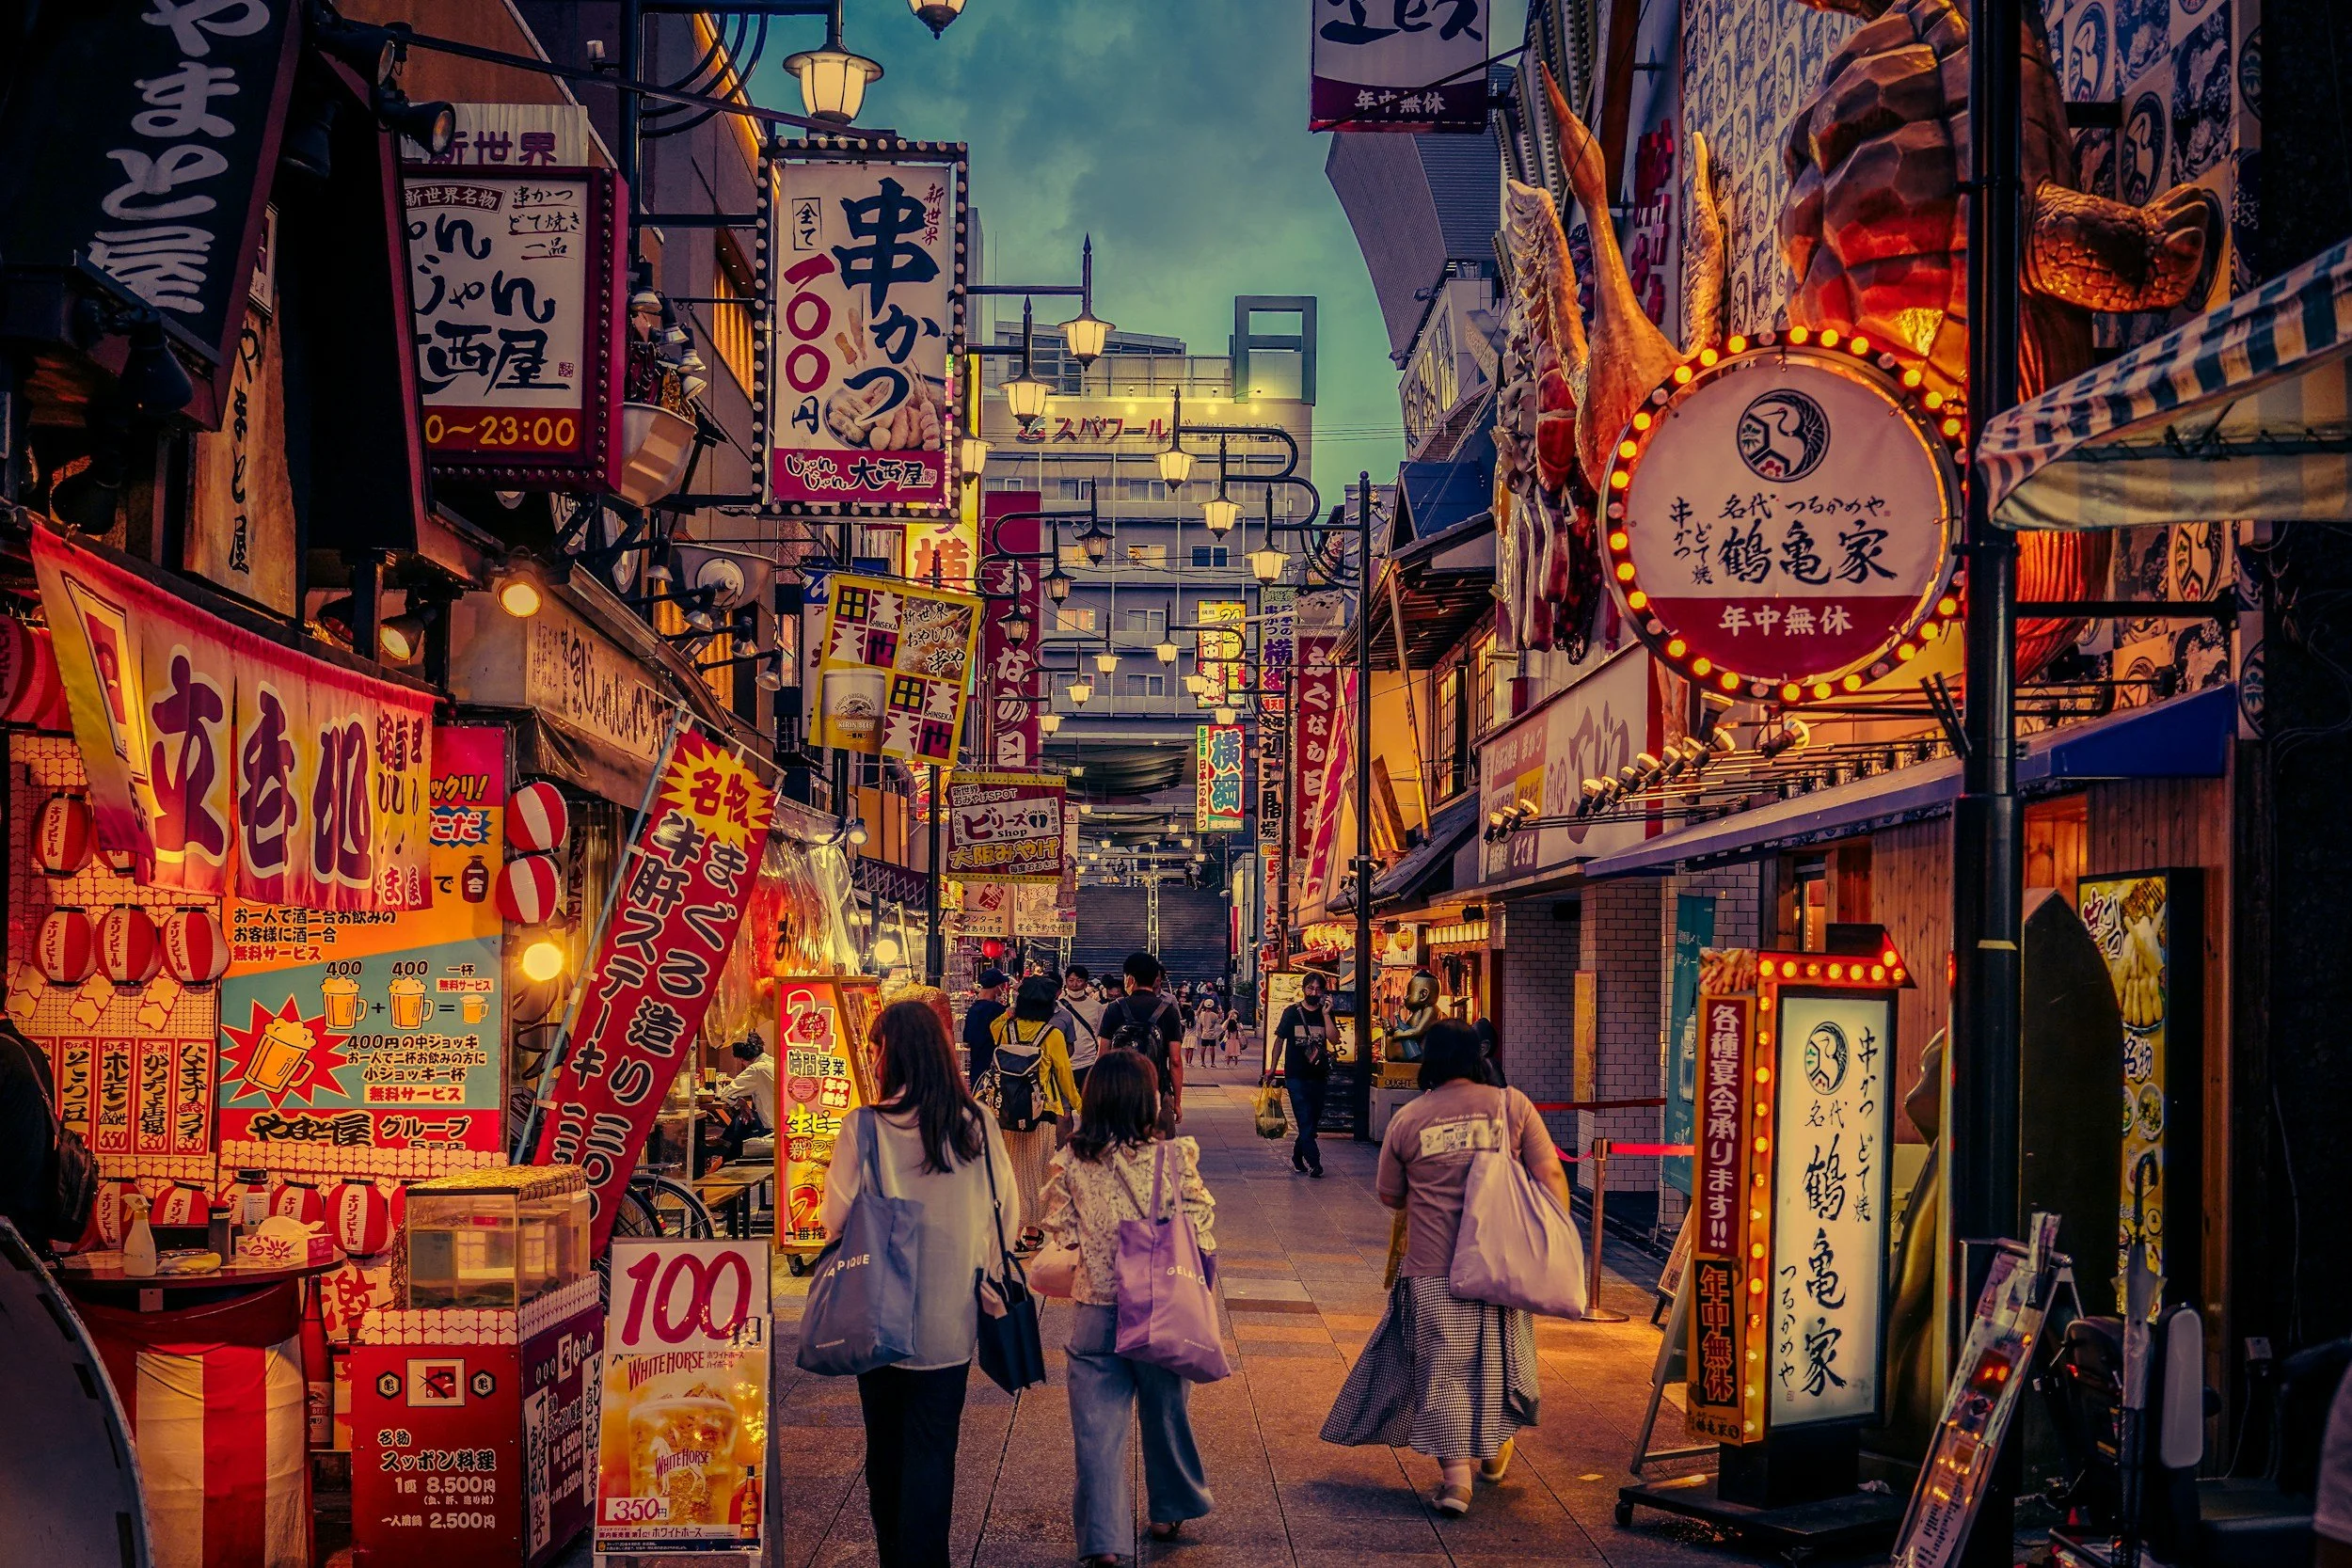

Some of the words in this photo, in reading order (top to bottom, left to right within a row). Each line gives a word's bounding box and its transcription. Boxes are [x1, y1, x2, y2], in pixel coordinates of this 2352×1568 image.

[1355, 89, 1446, 114] 年中無休
[405, 186, 498, 210] 新世界名物
[513, 185, 573, 208] 串かつ
[509, 212, 580, 232] どて焼き
[795, 201, 819, 247] 全て
[923, 182, 945, 246] 新世界
[524, 237, 568, 259] 一品
[832, 177, 941, 425] 串かつ
[420, 320, 570, 397] 西屋
[1052, 418, 1174, 443] スパワール
[849, 455, 925, 491] 大西屋
[1718, 493, 1777, 519] 名代
[1784, 496, 1885, 516] つるかめや
[1669, 496, 1693, 561] 串かつ
[1691, 521, 1714, 585] どて焼
[1717, 519, 1898, 585] 鶴亀家
[903, 602, 947, 626] 新世界
[1719, 605, 1852, 636] 年中無休
[907, 626, 954, 647] おやじの
[927, 647, 966, 677] 串や
[690, 767, 751, 829] 名物
[952, 785, 979, 797] 新世界
[962, 807, 1028, 840] ビリーズ
[997, 829, 1027, 839] Shop
[950, 837, 1059, 867] 大阪みやげ
[467, 868, 485, 894] 一合
[44, 920, 58, 973] キリンビール
[109, 914, 123, 968] キリンビール
[167, 920, 187, 973] キリンビール
[233, 927, 337, 943] お客様に酒一合
[233, 945, 323, 962] 無料サービス
[326, 961, 362, 976] 400
[391, 961, 429, 976] 400
[447, 963, 475, 976] 一杯
[438, 979, 491, 991] 無料サービス
[784, 989, 836, 1054] 24
[346, 1052, 486, 1066] お一人で二杯お飲みの方に
[788, 1049, 847, 1077] 時間営業
[1855, 1026, 1879, 1120] 串かつ
[369, 1085, 462, 1101] 無料サービス
[1707, 1003, 1740, 1249] 各種宴会承ります!!
[1804, 1098, 1846, 1130] 名代
[99, 1131, 128, 1150] 550
[249, 1112, 374, 1147] やまと屋
[380, 1117, 471, 1139] グループ
[1852, 1132, 1876, 1223] どて焼
[346, 1194, 361, 1245] キリンビール
[1800, 1132, 1849, 1398] 鶴亀家
[1700, 1266, 1735, 1403] 年中無休
[1777, 1266, 1796, 1389] つるかめや
[706, 1351, 745, 1360] ホワイトホース
[628, 1354, 665, 1392] WHITE
[666, 1351, 705, 1374] HORSE
[377, 1429, 412, 1448] 名物
[380, 1448, 498, 1473] スッポン料理
[655, 1454, 681, 1481] WHITE
[681, 1448, 710, 1468] HORSE
[426, 1476, 497, 1495] 8,500円
[430, 1512, 497, 1529] 2,500円
[651, 1527, 703, 1539] ホワイトホース
